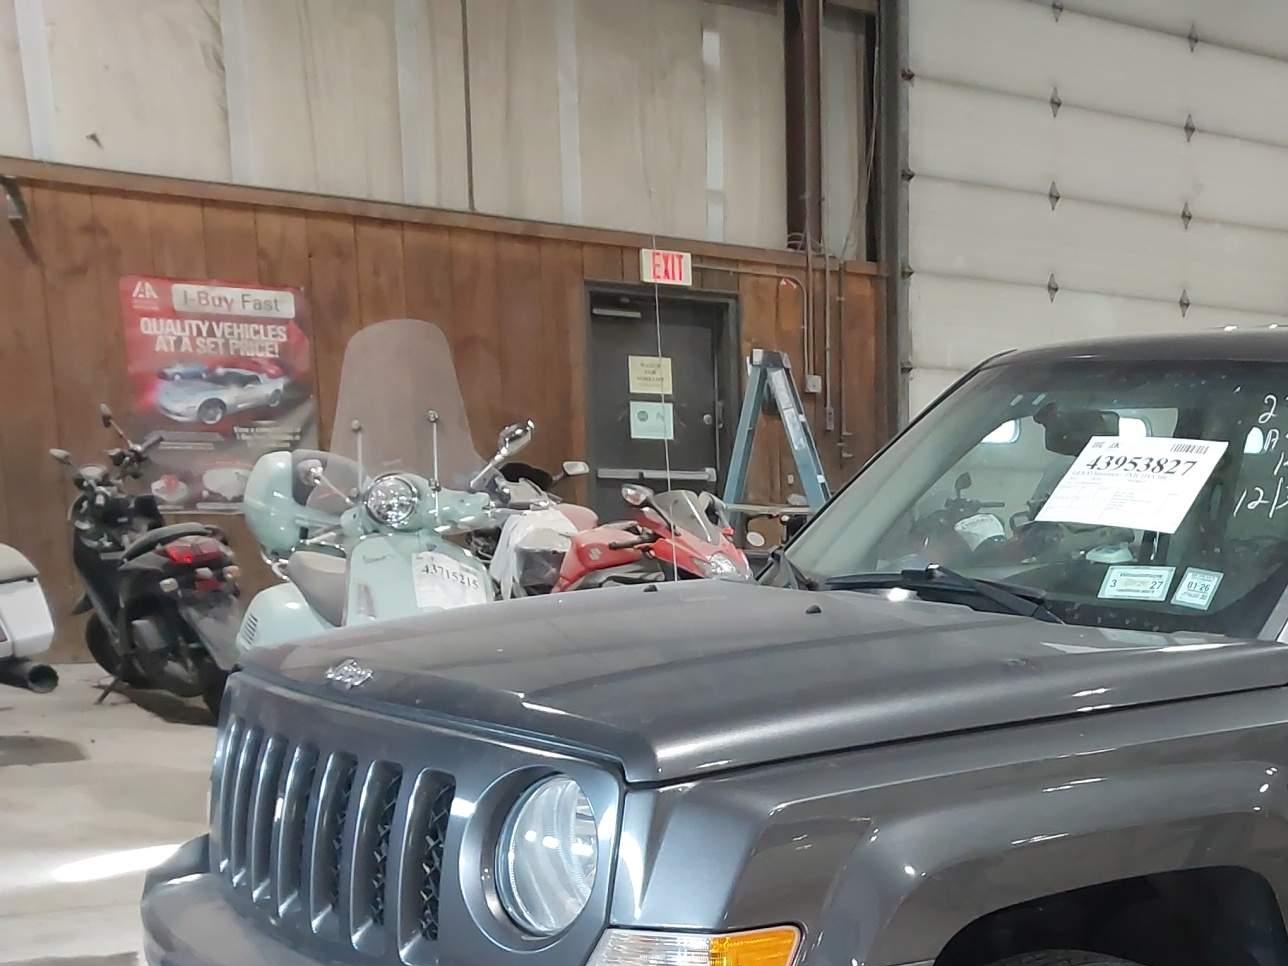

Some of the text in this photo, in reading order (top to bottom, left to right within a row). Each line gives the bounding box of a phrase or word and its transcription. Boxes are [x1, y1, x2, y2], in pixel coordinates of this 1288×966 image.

[652, 252, 684, 281] EXIT
[183, 289, 281, 312] I-Buy Fast
[140, 317, 288, 342] QUALITY VEHICLES
[155, 335, 280, 358] AT A SET PRICE!
[1086, 454, 1198, 476] 43953827
[421, 563, 480, 590] 43715215
[1150, 580, 1164, 590] 27
